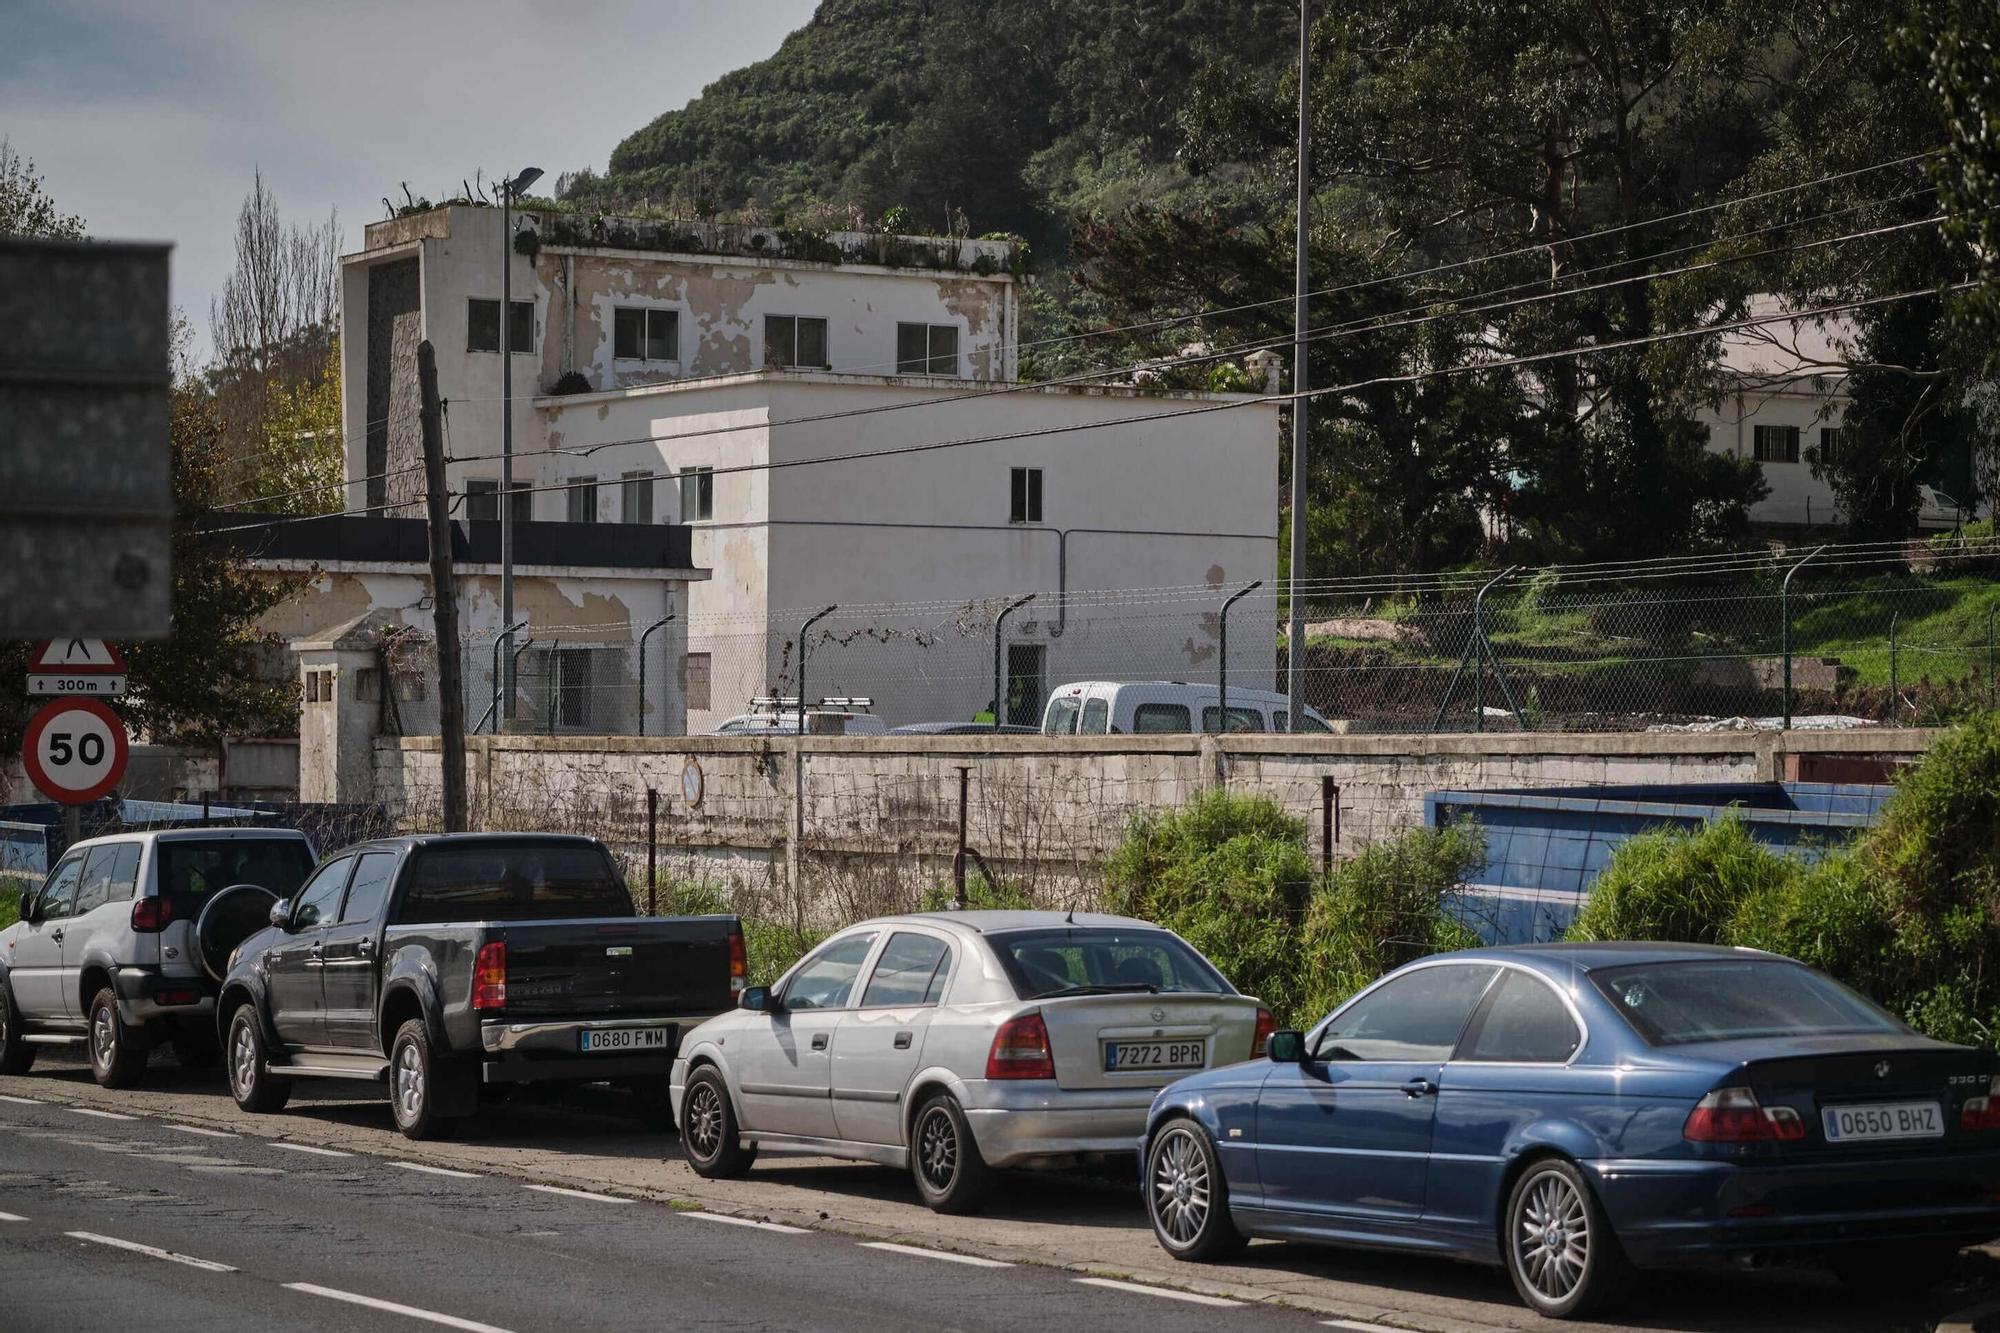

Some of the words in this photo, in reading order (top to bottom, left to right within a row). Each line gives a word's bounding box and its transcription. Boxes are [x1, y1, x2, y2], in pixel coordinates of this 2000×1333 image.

[57, 679, 98, 692] 300m
[48, 732, 105, 767] 50
[592, 1030, 630, 1048] 0680
[635, 1028, 664, 1046] FWM
[1118, 1046, 1162, 1065] 7272
[1170, 1044, 1201, 1063] BPR
[1841, 1110, 1893, 1135] 0650
[1898, 1108, 1937, 1132] BHZ
